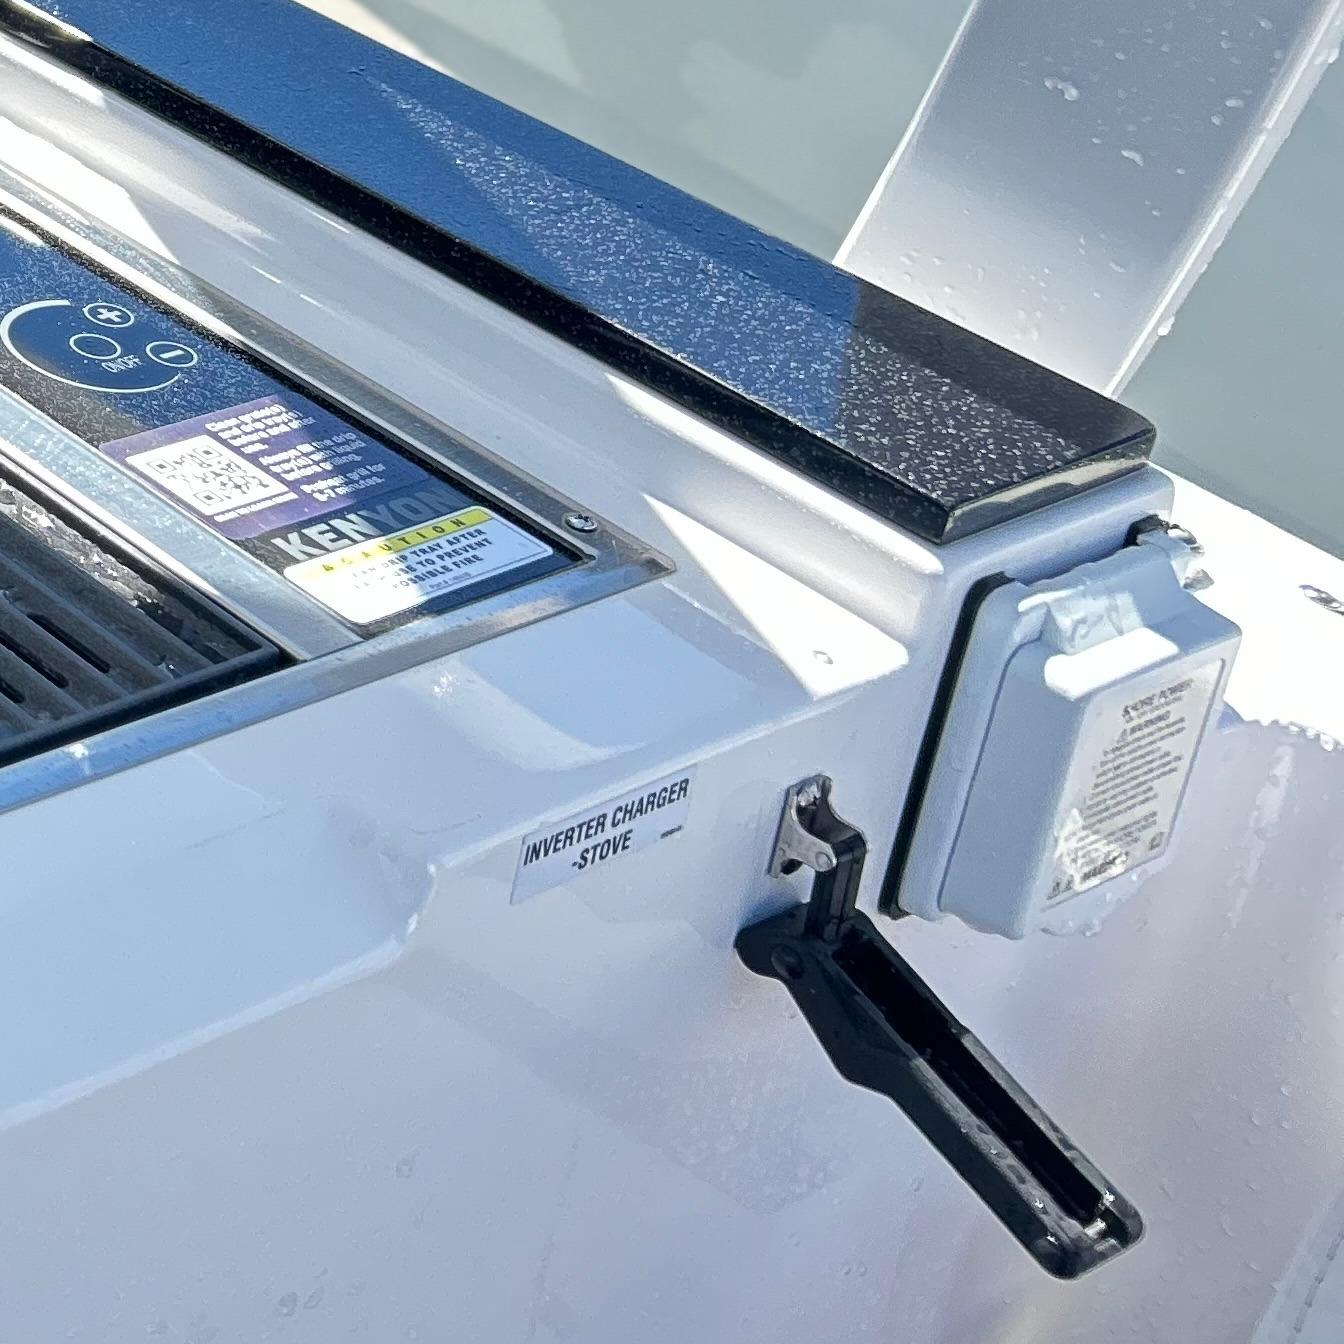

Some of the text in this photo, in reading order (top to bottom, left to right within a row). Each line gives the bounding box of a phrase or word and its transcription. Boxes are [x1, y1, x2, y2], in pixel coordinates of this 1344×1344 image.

[218, 427, 241, 440] and
[266, 423, 292, 436] and
[312, 436, 332, 449] the
[332, 431, 357, 446] drip
[309, 448, 336, 462] with
[332, 439, 367, 456] liquid
[300, 461, 387, 494] Preheat grill for
[334, 475, 386, 496] minutes.
[271, 489, 462, 562] KENYON
[341, 517, 467, 566] CAUTION
[411, 542, 445, 558] TRAY
[446, 527, 488, 546] AFTER
[416, 556, 436, 570] TO
[438, 537, 494, 563] PREVENT
[391, 564, 453, 591] POSSIBLE
[453, 553, 485, 572] FIRE
[523, 778, 690, 866] INVERTER CHARGER
